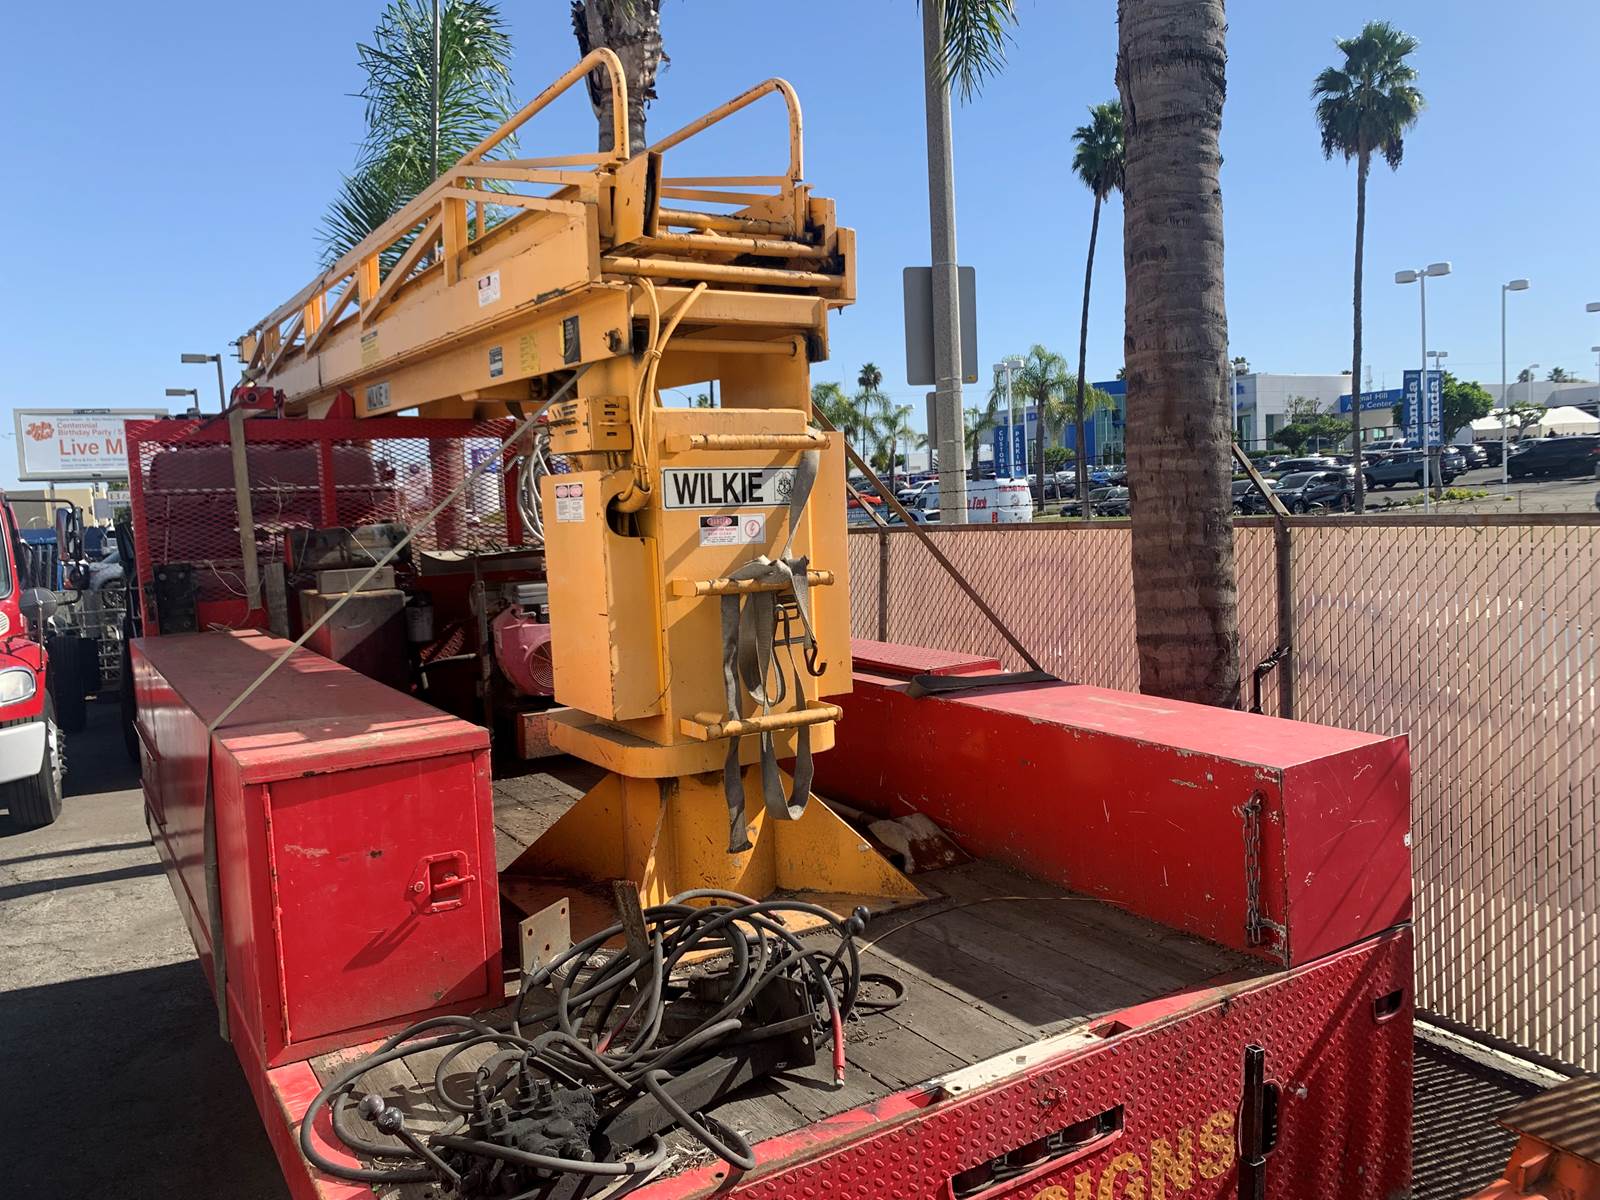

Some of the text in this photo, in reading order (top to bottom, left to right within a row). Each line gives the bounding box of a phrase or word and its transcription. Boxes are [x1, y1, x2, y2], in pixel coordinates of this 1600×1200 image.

[1375, 392, 1388, 400] Hill
[1407, 381, 1419, 443] Honda
[1428, 381, 1440, 443] Honda
[92, 428, 112, 436] Party
[59, 439, 99, 455] Live
[672, 472, 763, 504] WILKIE
